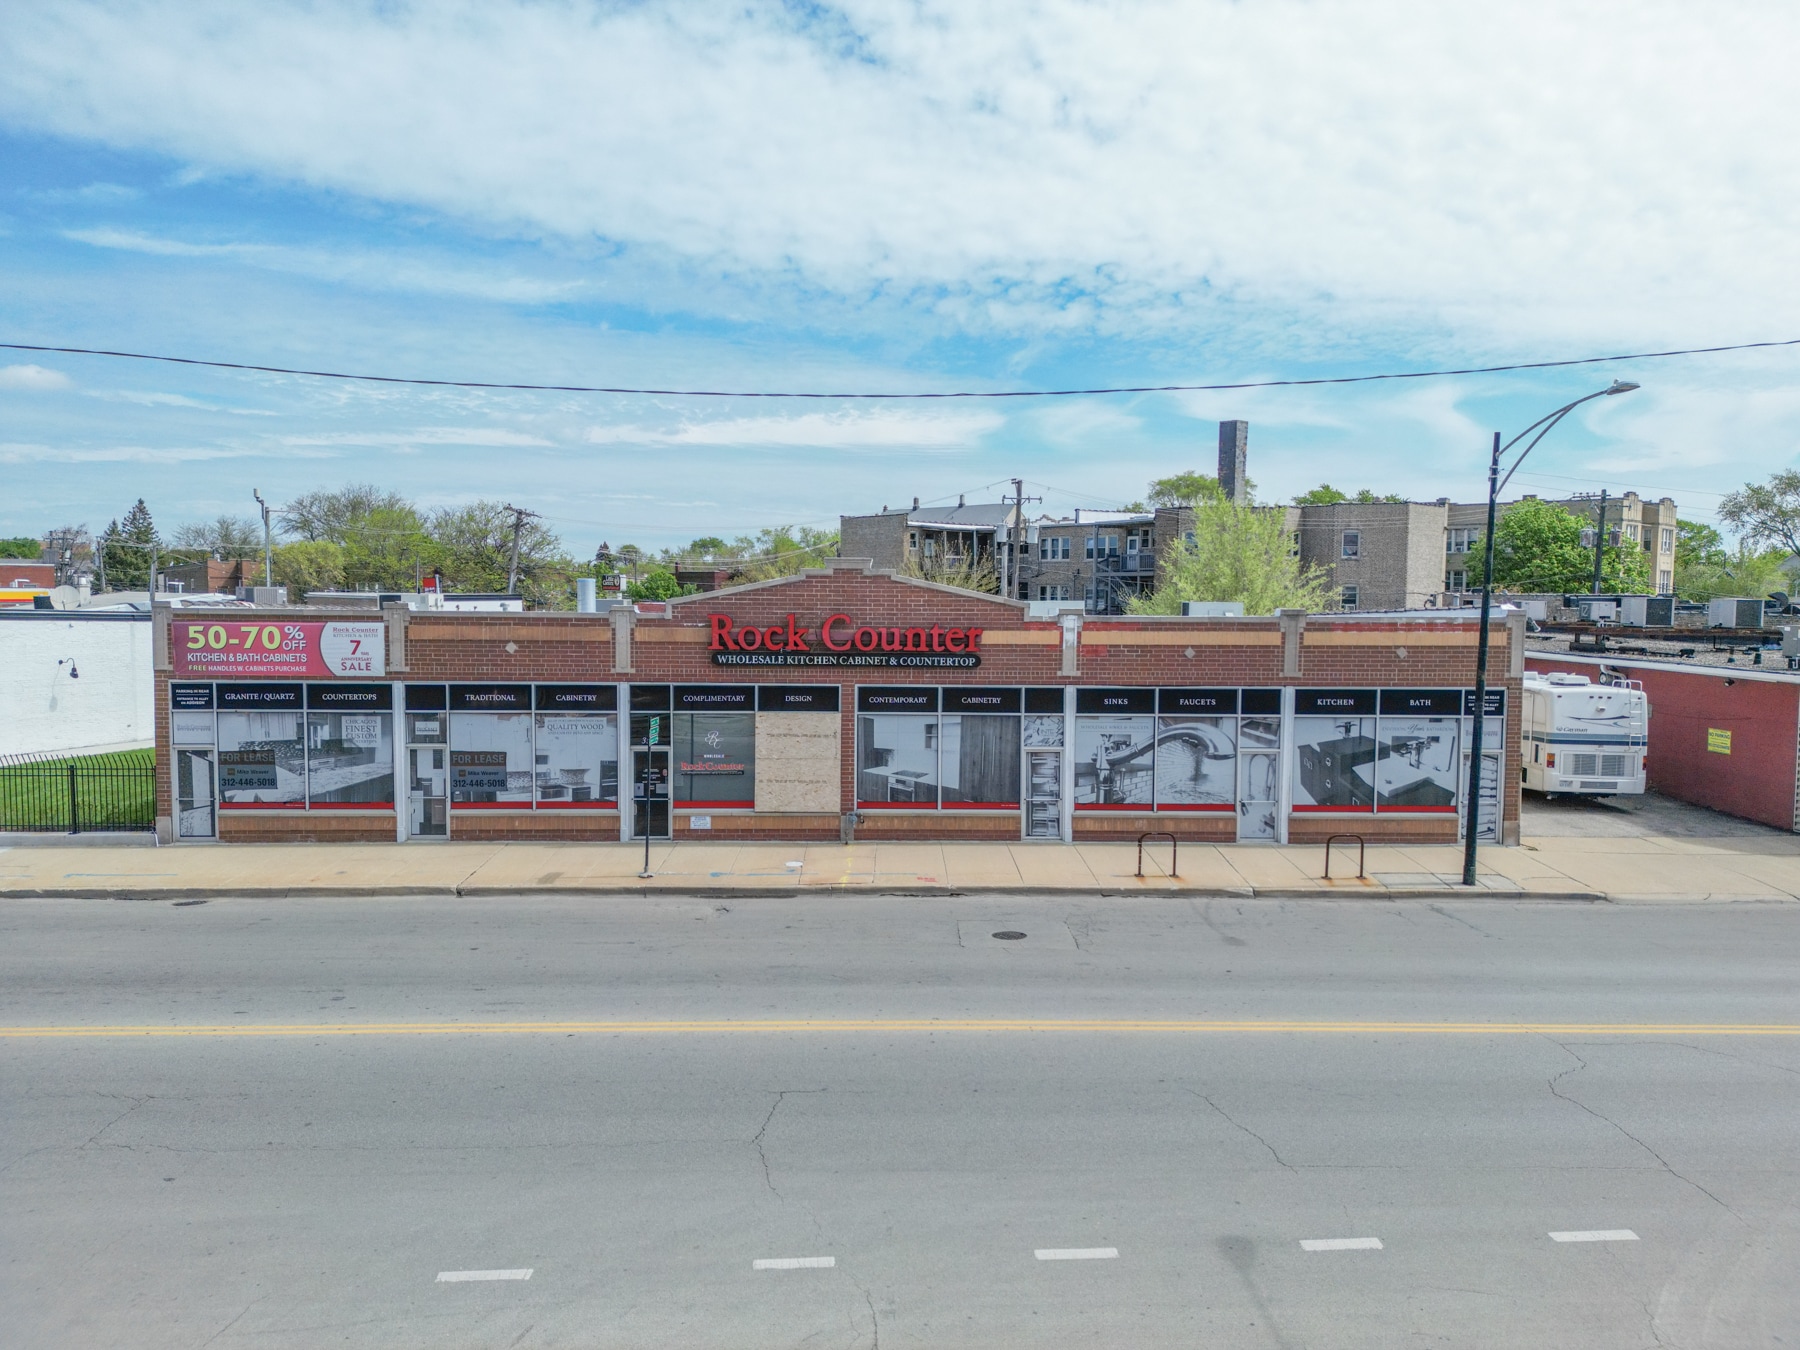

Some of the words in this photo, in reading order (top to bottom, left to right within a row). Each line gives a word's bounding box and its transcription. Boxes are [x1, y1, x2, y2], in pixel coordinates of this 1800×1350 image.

[186, 625, 281, 649] 50-70
[707, 614, 810, 651] Rock
[822, 614, 983, 652] Counter
[282, 641, 306, 651] OFF
[350, 640, 361, 655] 7
[187, 653, 228, 663] KITCHEN
[228, 653, 235, 662] &
[237, 653, 261, 663] BATH
[262, 653, 307, 663] CABINETS
[717, 654, 784, 665] WHOLESALE
[787, 655, 837, 665] KITCHEN
[839, 655, 888, 665] CABINET
[889, 656, 898, 665] &
[900, 657, 976, 666] COUNTERTOP
[341, 661, 372, 671] SALE
[264, 693, 295, 701] QUARTZ
[322, 693, 377, 701] COUNTERTOPS
[221, 754, 241, 762] FOR
[244, 754, 274, 762] LEASE
[452, 754, 471, 763] FOR
[475, 754, 505, 763] LEASE
[221, 778, 276, 787] 312-446-5018
[453, 779, 505, 788] 312-446-5018
